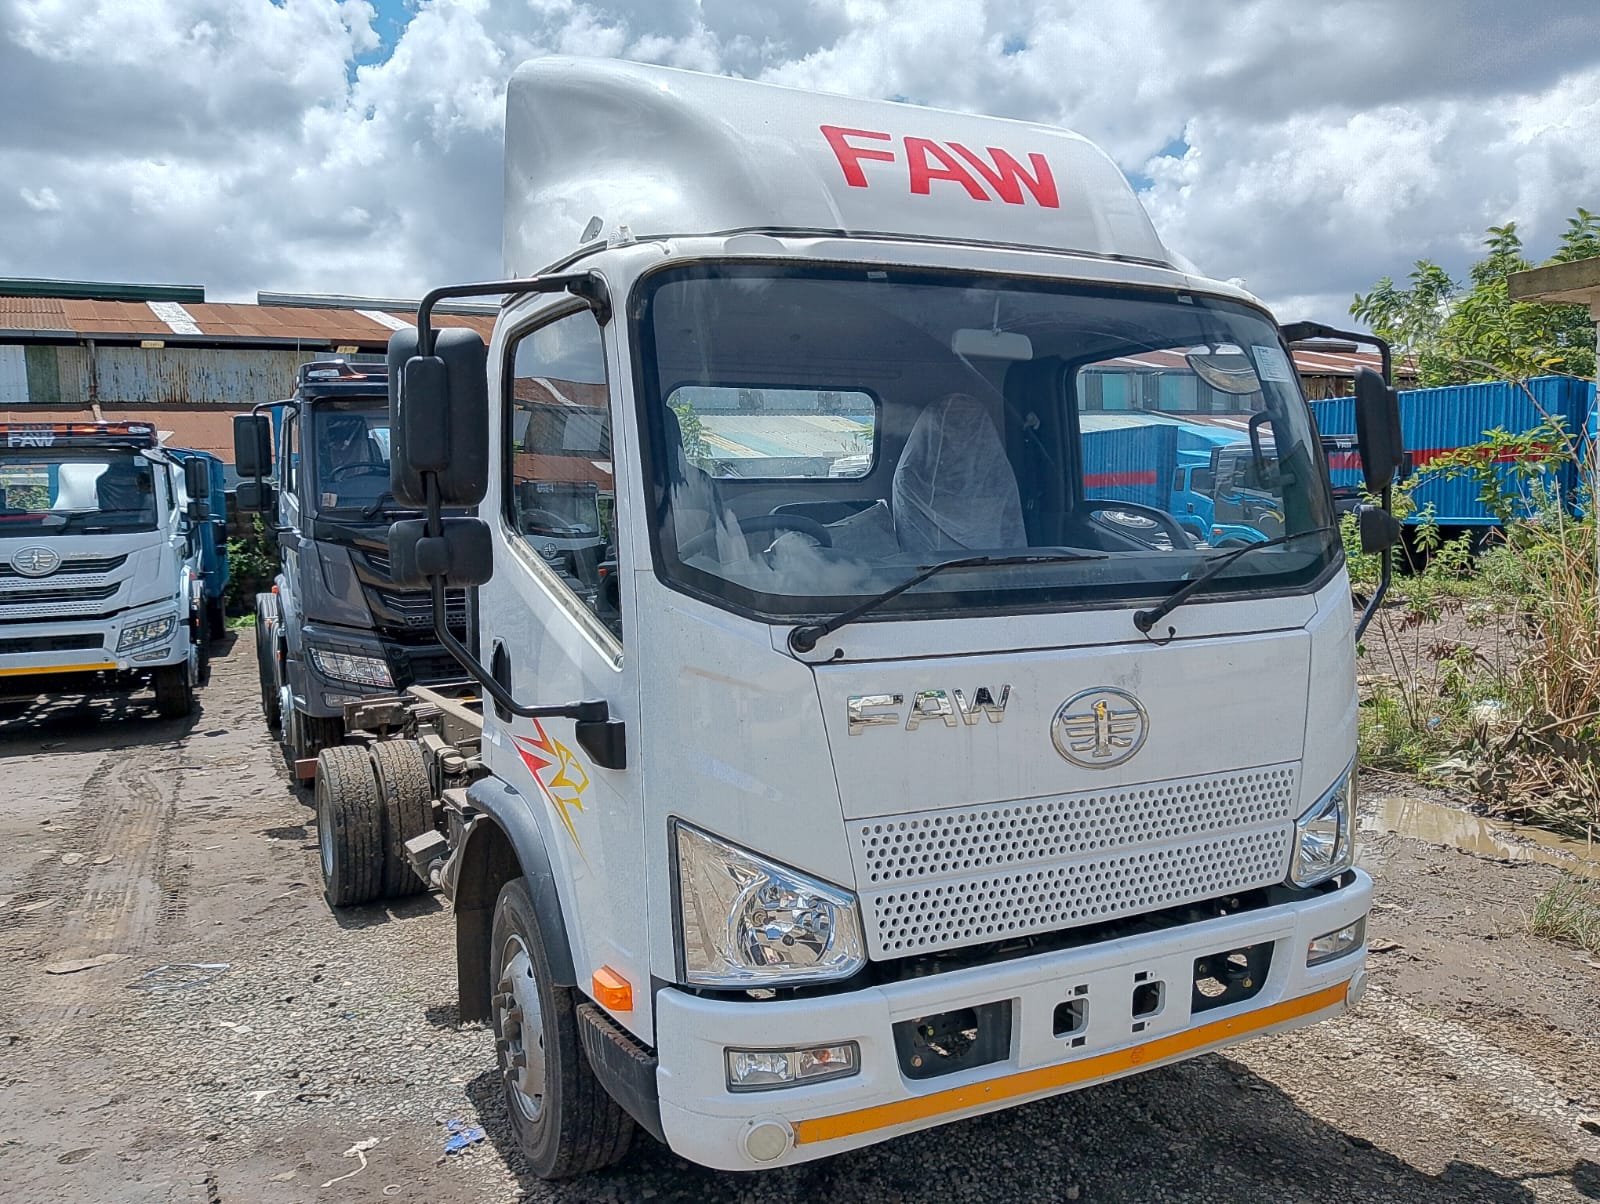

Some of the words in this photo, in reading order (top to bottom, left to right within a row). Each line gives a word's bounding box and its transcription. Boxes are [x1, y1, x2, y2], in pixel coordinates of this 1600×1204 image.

[819, 125, 1060, 209] FAW
[7, 434, 55, 448] FAW
[847, 684, 1012, 737] FAW
